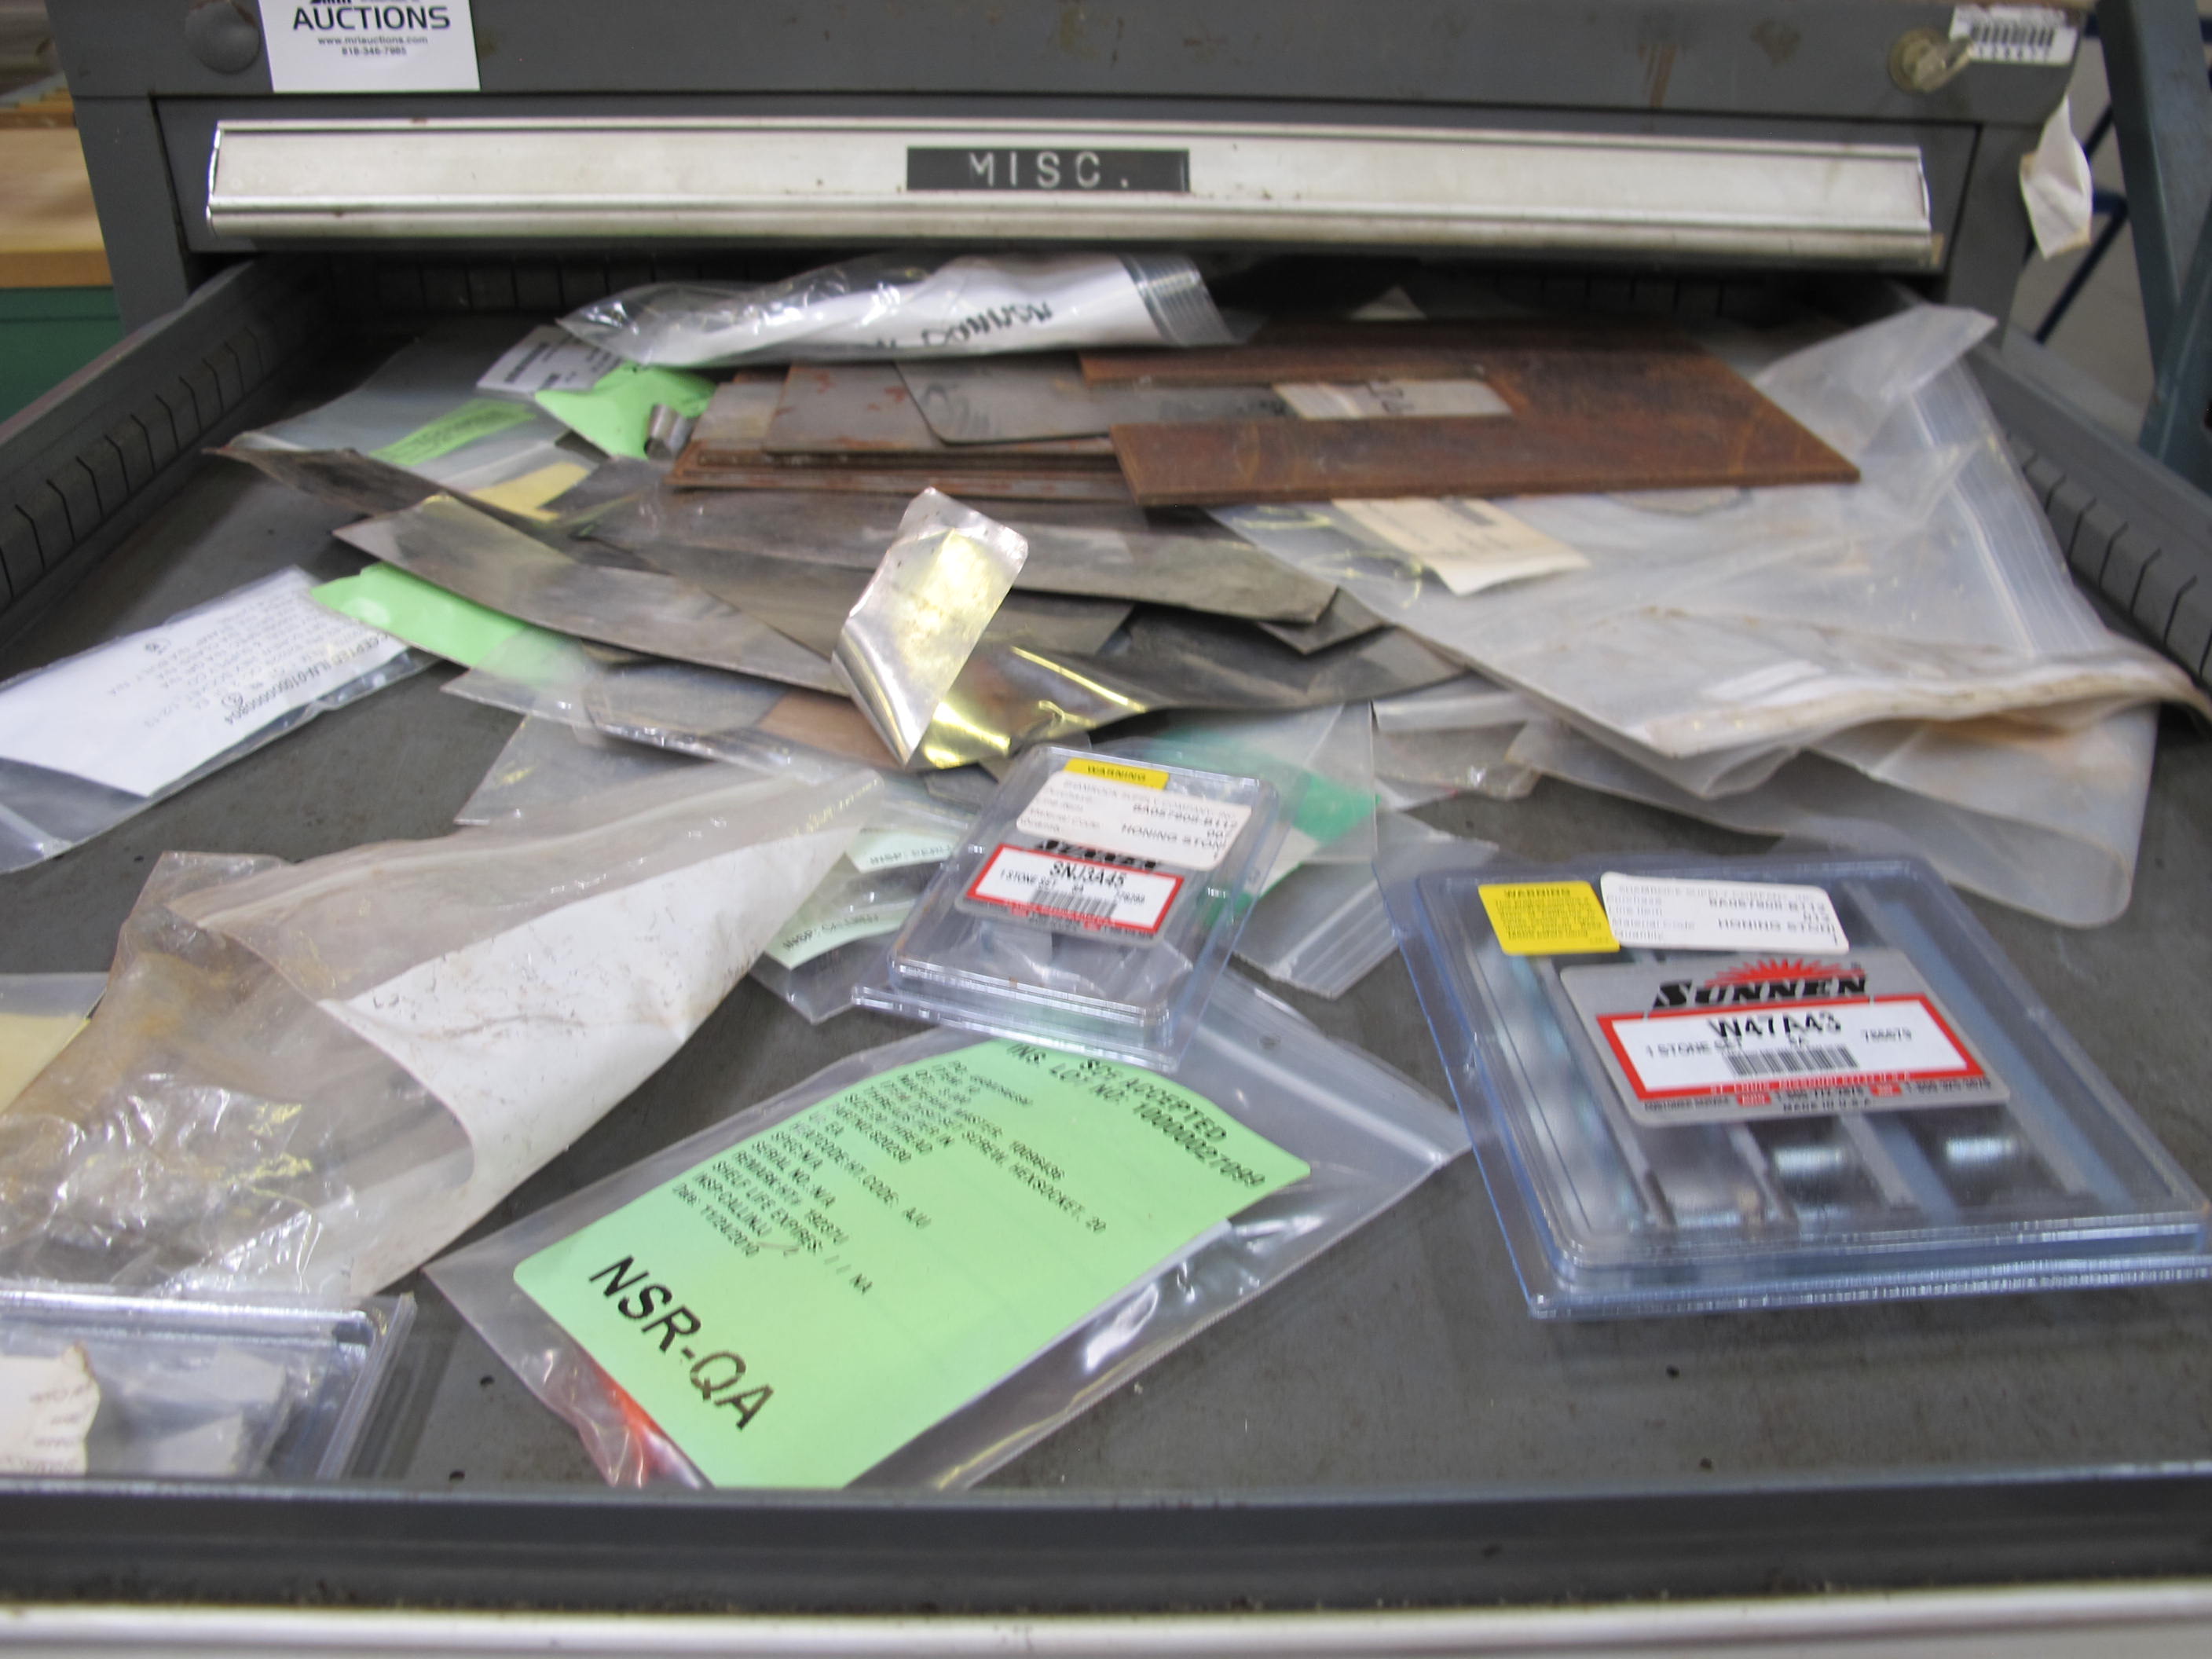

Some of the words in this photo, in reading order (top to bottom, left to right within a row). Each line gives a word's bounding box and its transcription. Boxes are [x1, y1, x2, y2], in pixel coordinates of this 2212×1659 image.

[292, 7, 451, 31] AUCTIONS
[969, 152, 1129, 189] MISC.
[1049, 860, 1127, 888] SNJ3A45
[1652, 974, 1866, 1009] SUNNEN
[1707, 1012, 1842, 1038] W47A43
[1120, 1077, 1227, 1141] ACCEPTED
[712, 1160, 751, 1188] SHELF
[589, 1254, 774, 1430] NSR-QA
